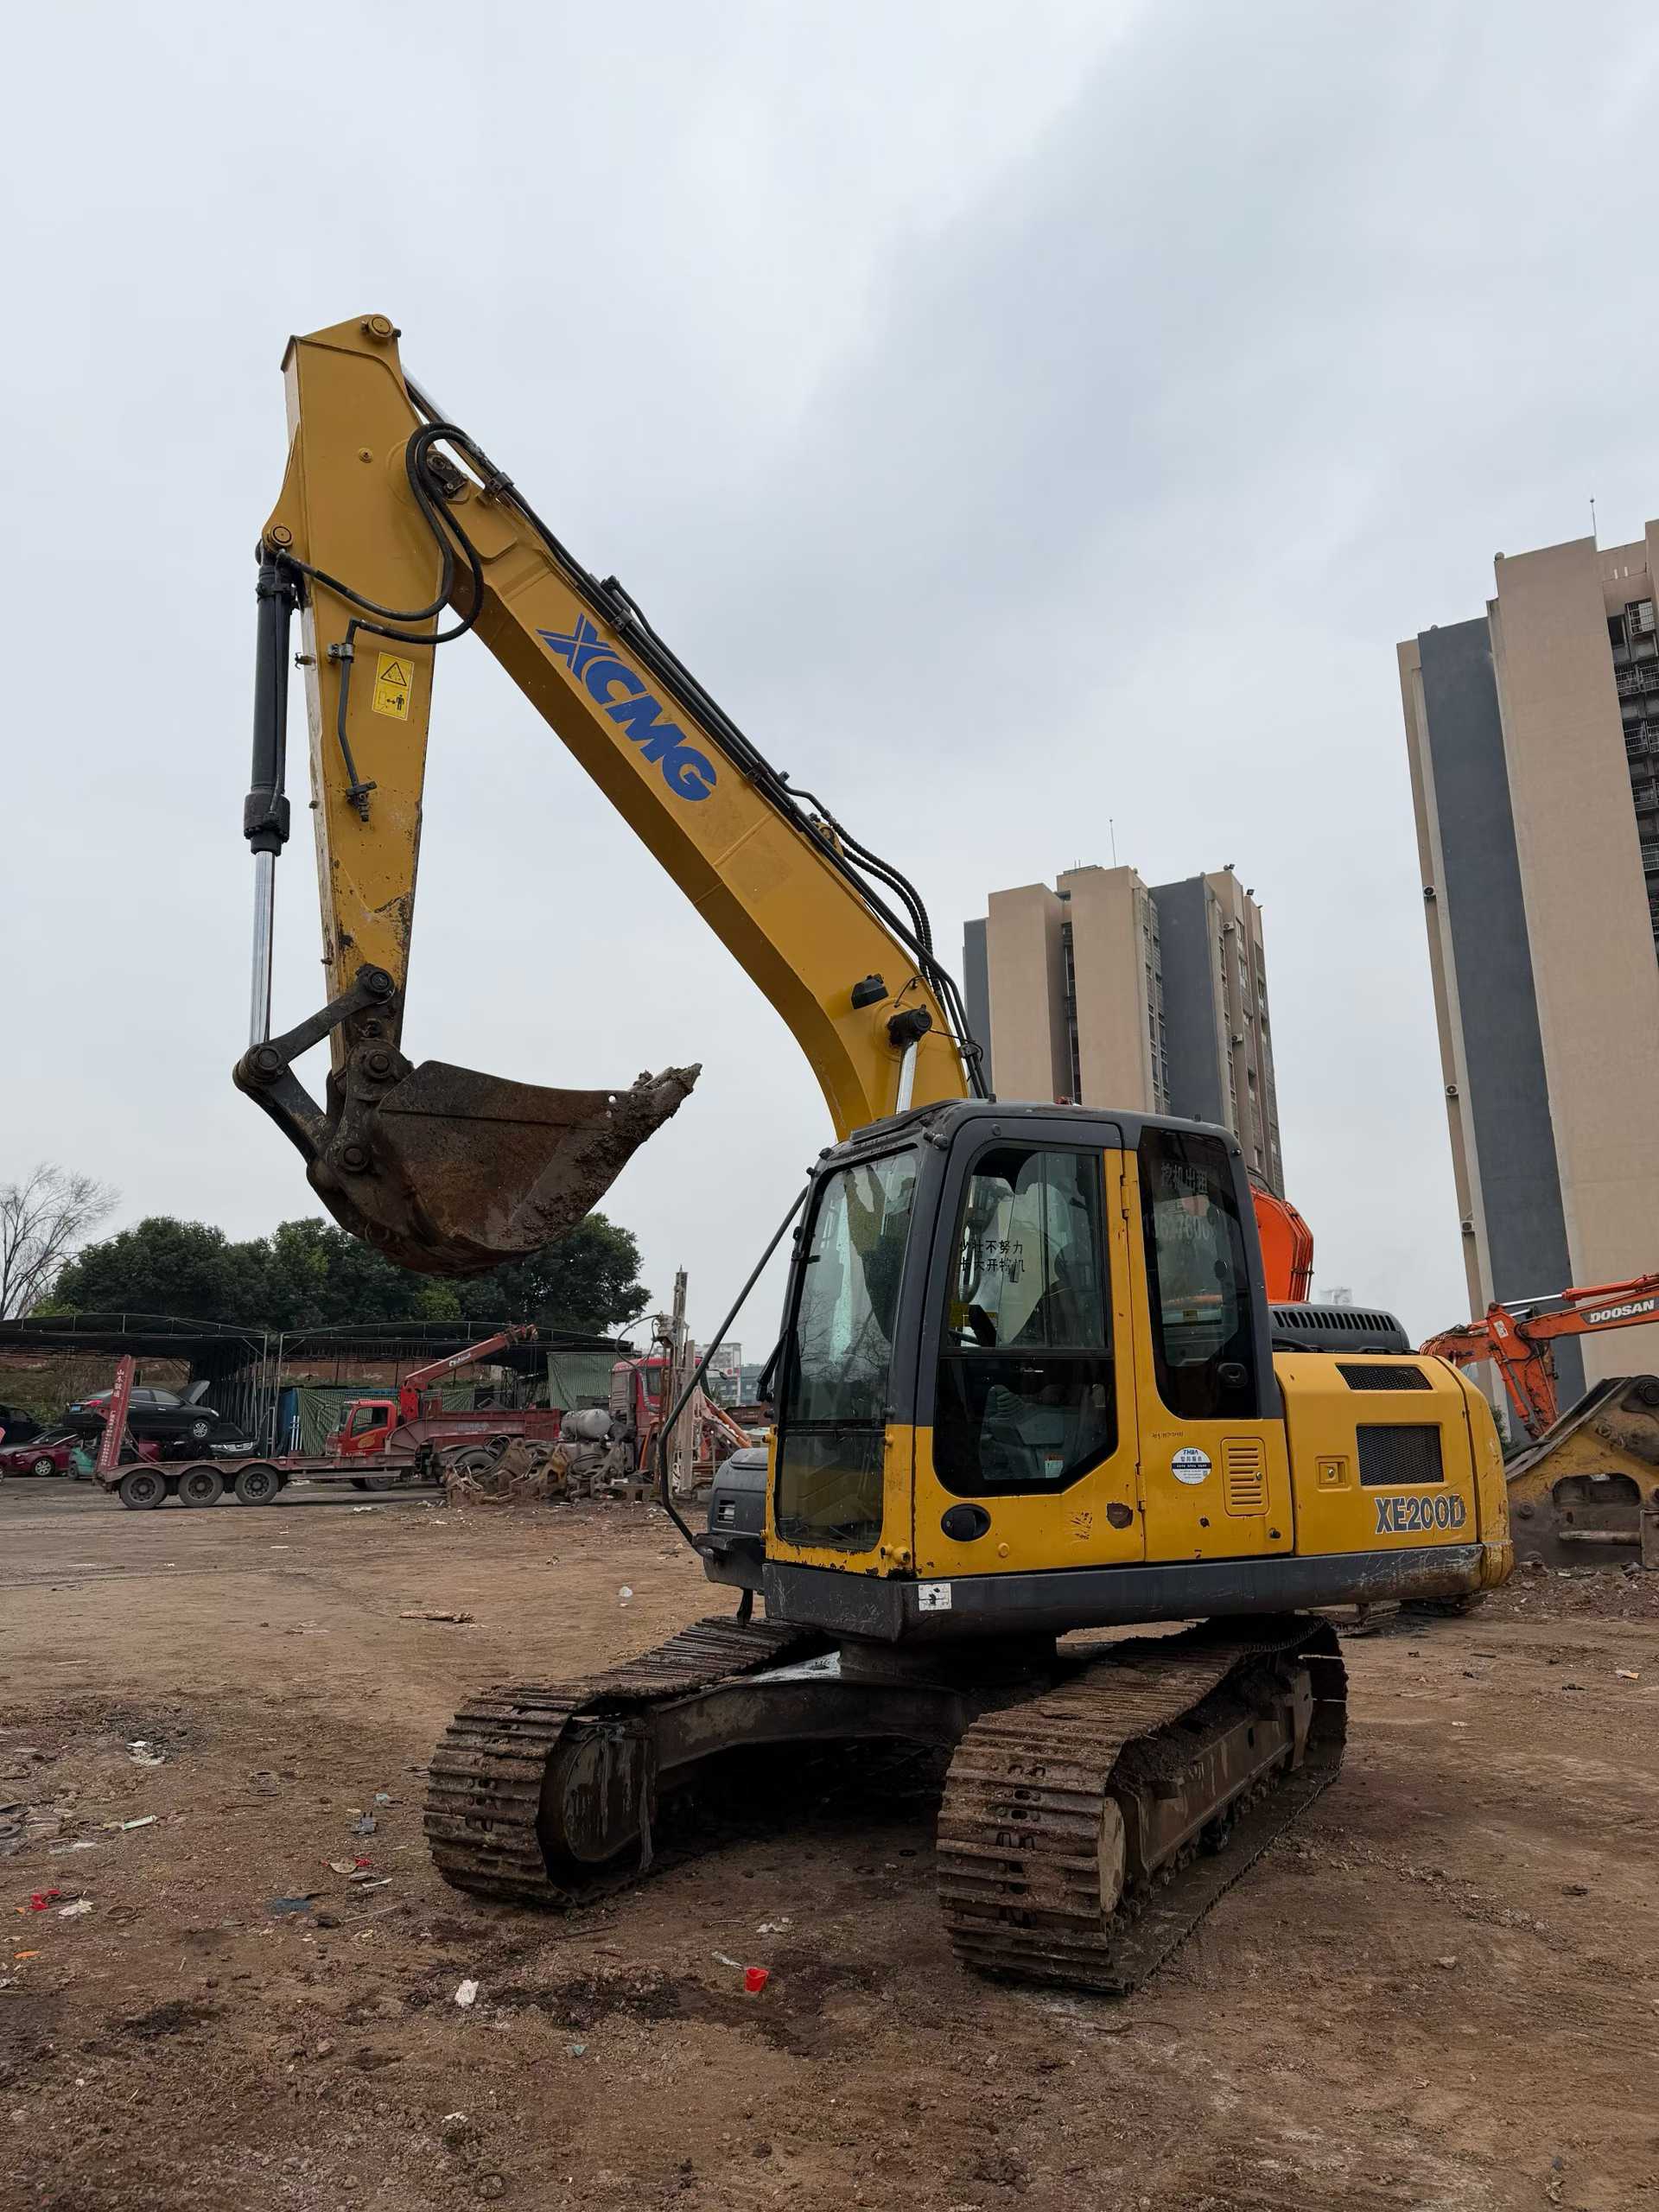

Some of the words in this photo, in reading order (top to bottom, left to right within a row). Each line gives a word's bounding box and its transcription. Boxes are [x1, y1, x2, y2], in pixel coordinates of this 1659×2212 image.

[536, 613, 717, 802] XCMG
[960, 1238, 1023, 1255] 少壮不努力
[1590, 1300, 1655, 1323] DOOSAN
[1374, 1494, 1466, 1534] XE200D
